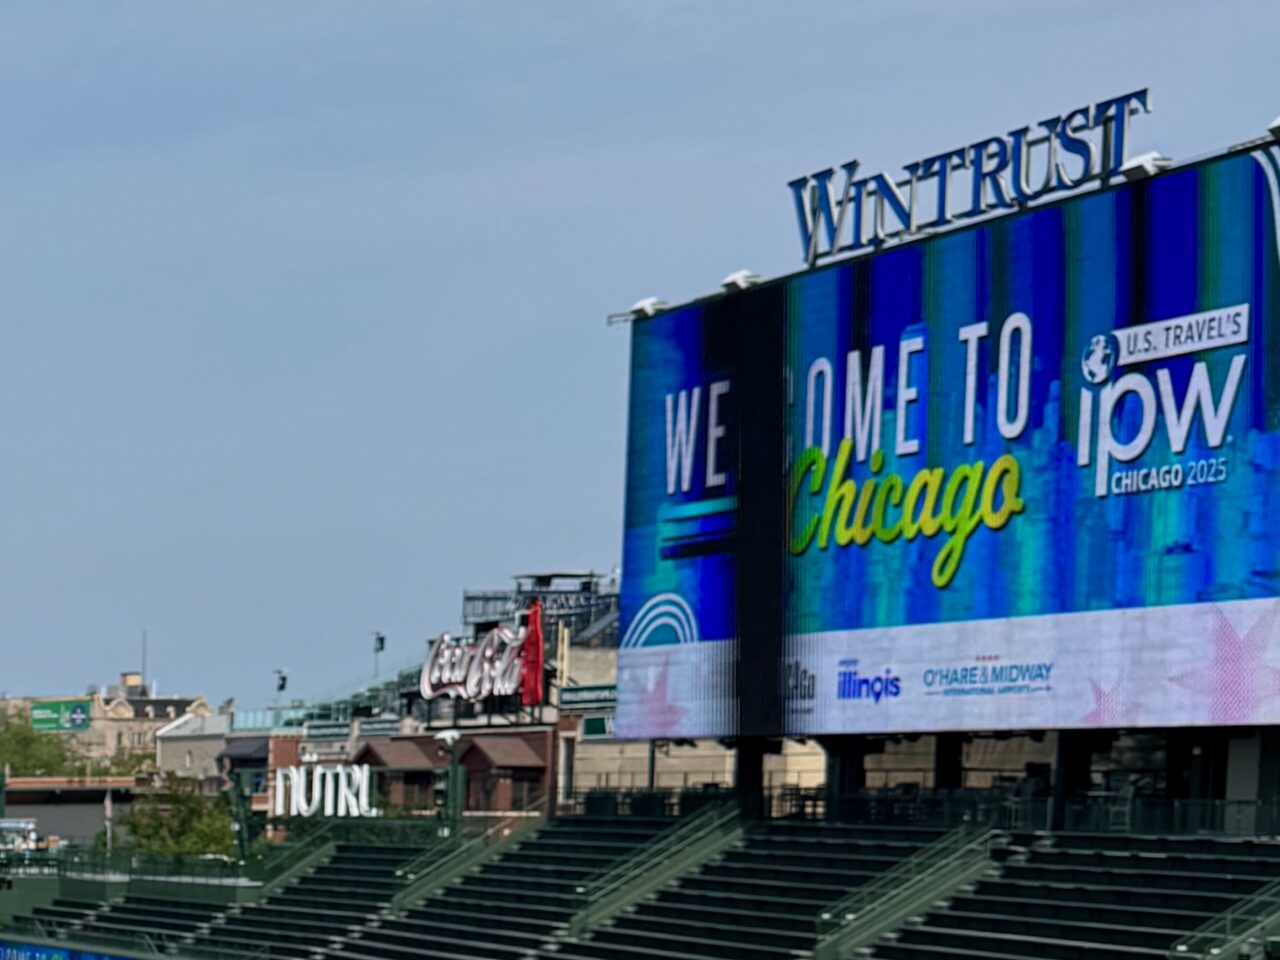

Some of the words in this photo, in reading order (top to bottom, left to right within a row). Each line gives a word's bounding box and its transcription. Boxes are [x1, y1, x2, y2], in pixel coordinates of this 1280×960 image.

[787, 87, 1154, 268] WINTRUST
[1125, 331, 1157, 356] U.S.
[1163, 311, 1242, 349] TRAVEL'S
[958, 312, 1033, 444] TO
[1077, 335, 1247, 497] ipw
[788, 438, 1025, 589] Chicago
[1111, 463, 1183, 495] CHICAGO
[1186, 457, 1227, 485] 2025
[836, 668, 902, 704] illinois
[990, 662, 1054, 684] MIDWAY
